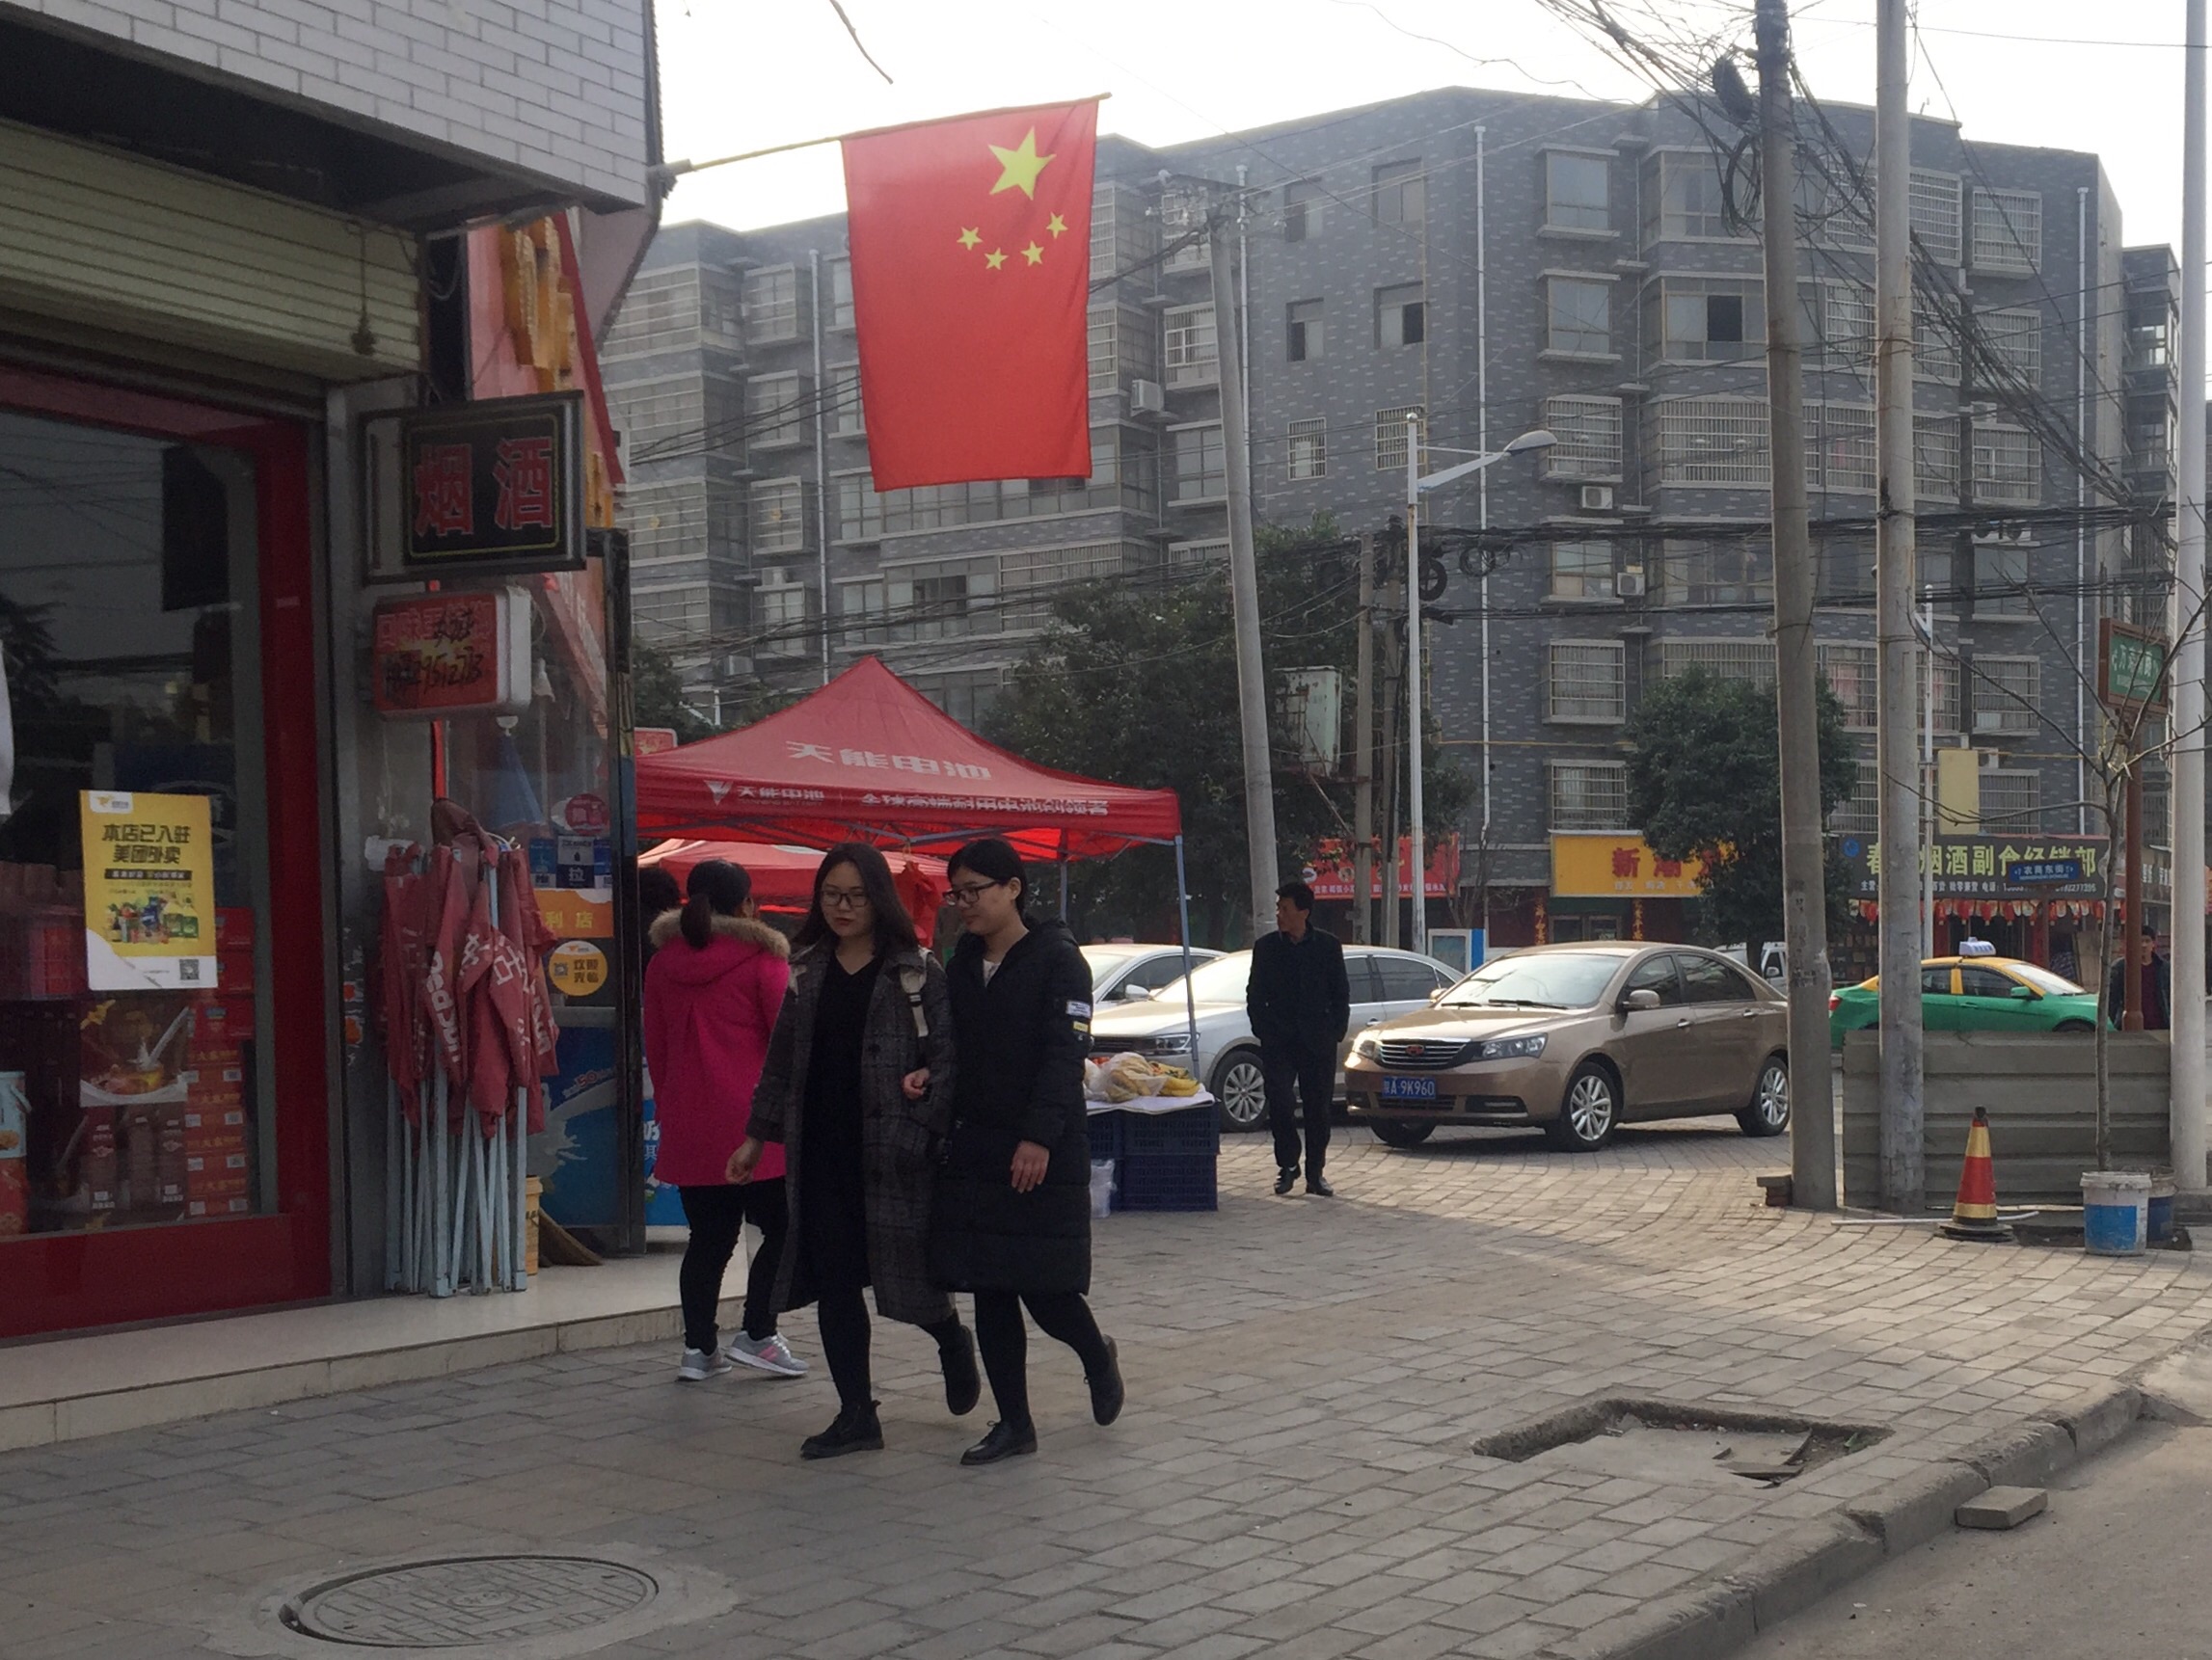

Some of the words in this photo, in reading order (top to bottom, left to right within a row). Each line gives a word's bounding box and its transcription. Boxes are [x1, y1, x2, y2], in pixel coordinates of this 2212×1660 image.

[415, 437, 553, 537] 烟酒
[785, 740, 992, 781] 天能电池
[737, 786, 825, 802] 天能电池
[102, 823, 192, 844] 本店已入驻
[113, 844, 181, 865] 美团外卖
[1866, 844, 2096, 878] 春烟酒副食部
